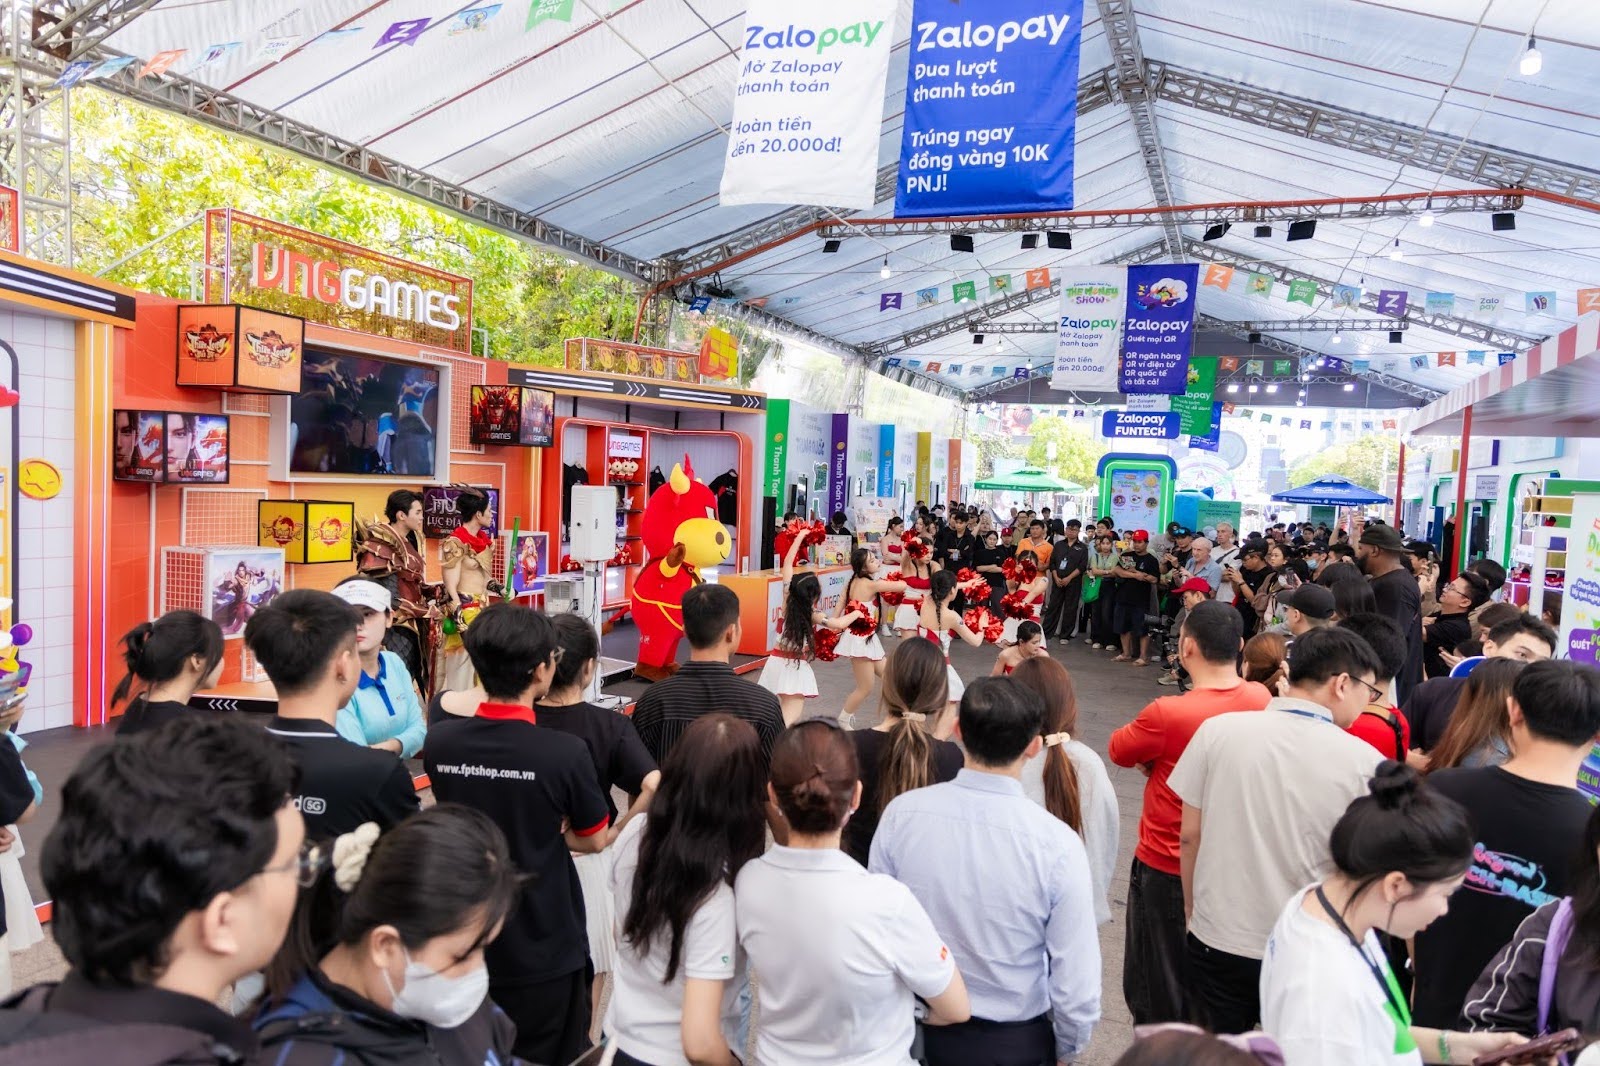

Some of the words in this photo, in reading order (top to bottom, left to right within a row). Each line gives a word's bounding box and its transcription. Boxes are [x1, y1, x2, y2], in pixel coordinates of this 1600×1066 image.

[746, 21, 884, 54] Zalopay
[917, 14, 1070, 52] Zalopay
[770, 59, 843, 76] Zalopay
[915, 63, 950, 80] Đua
[956, 58, 998, 80] lượt
[738, 79, 783, 96] thanh
[790, 80, 830, 92] toán
[914, 82, 965, 102] thanh
[971, 79, 1015, 96] toán
[778, 116, 812, 132] tiền
[760, 137, 842, 153] 20.000đ!
[911, 128, 960, 148] Trúng
[966, 126, 1014, 145] ngay
[908, 151, 952, 172] đồng
[958, 149, 1006, 168] vàng
[1012, 144, 1050, 163] 10K
[906, 174, 947, 194] PNJ!
[1480, 304, 1494, 312] pay
[1061, 316, 1118, 330] Zalopay
[1128, 318, 1190, 334] Zalopay
[1074, 332, 1103, 340] Zalopay
[1147, 336, 1162, 344] mọi
[1139, 352, 1159, 360] ngân
[1161, 352, 1181, 360] hàng
[1117, 414, 1166, 426] Zalopay
[1115, 426, 1166, 436] FUNTECH
[773, 446, 782, 475] Thanh
[836, 453, 844, 478] Thanh
[772, 478, 780, 497] Toá
[1571, 636, 1591, 650] QUÉT
[436, 763, 535, 781] www.fptshop.com.vn
